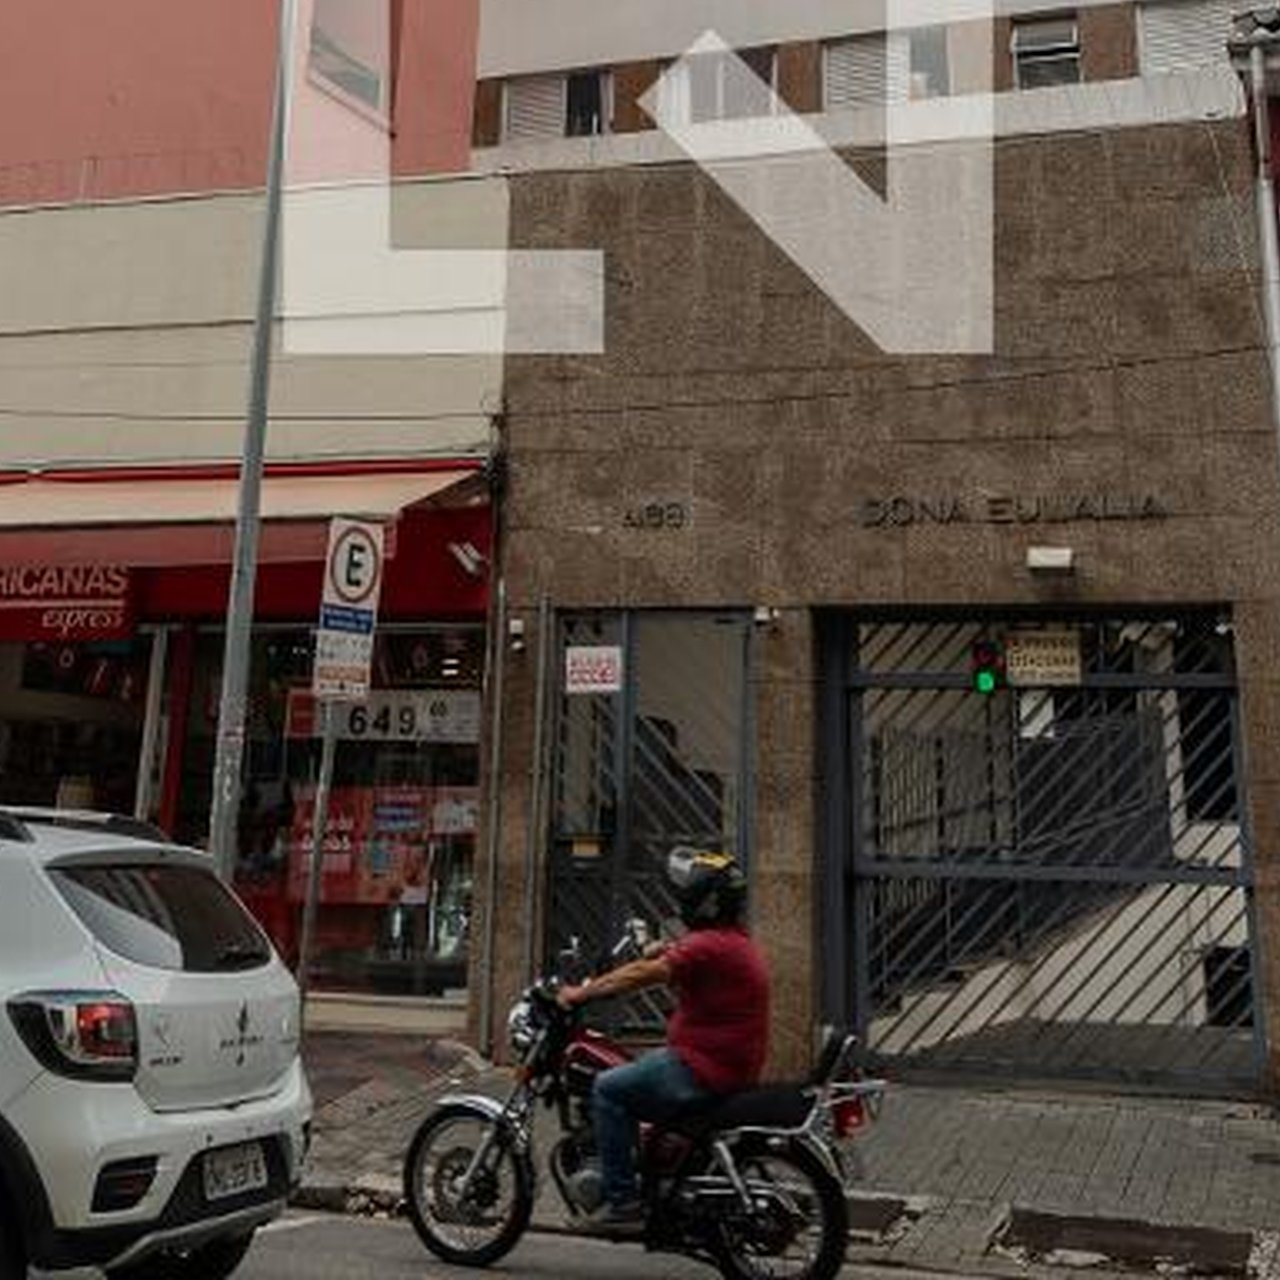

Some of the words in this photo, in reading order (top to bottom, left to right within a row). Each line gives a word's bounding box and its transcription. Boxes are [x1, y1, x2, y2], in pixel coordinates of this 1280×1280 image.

[862, 496, 963, 528] DONA
[985, 493, 1172, 524] EULALIA
[345, 543, 366, 587] E
[41, 608, 125, 637] express
